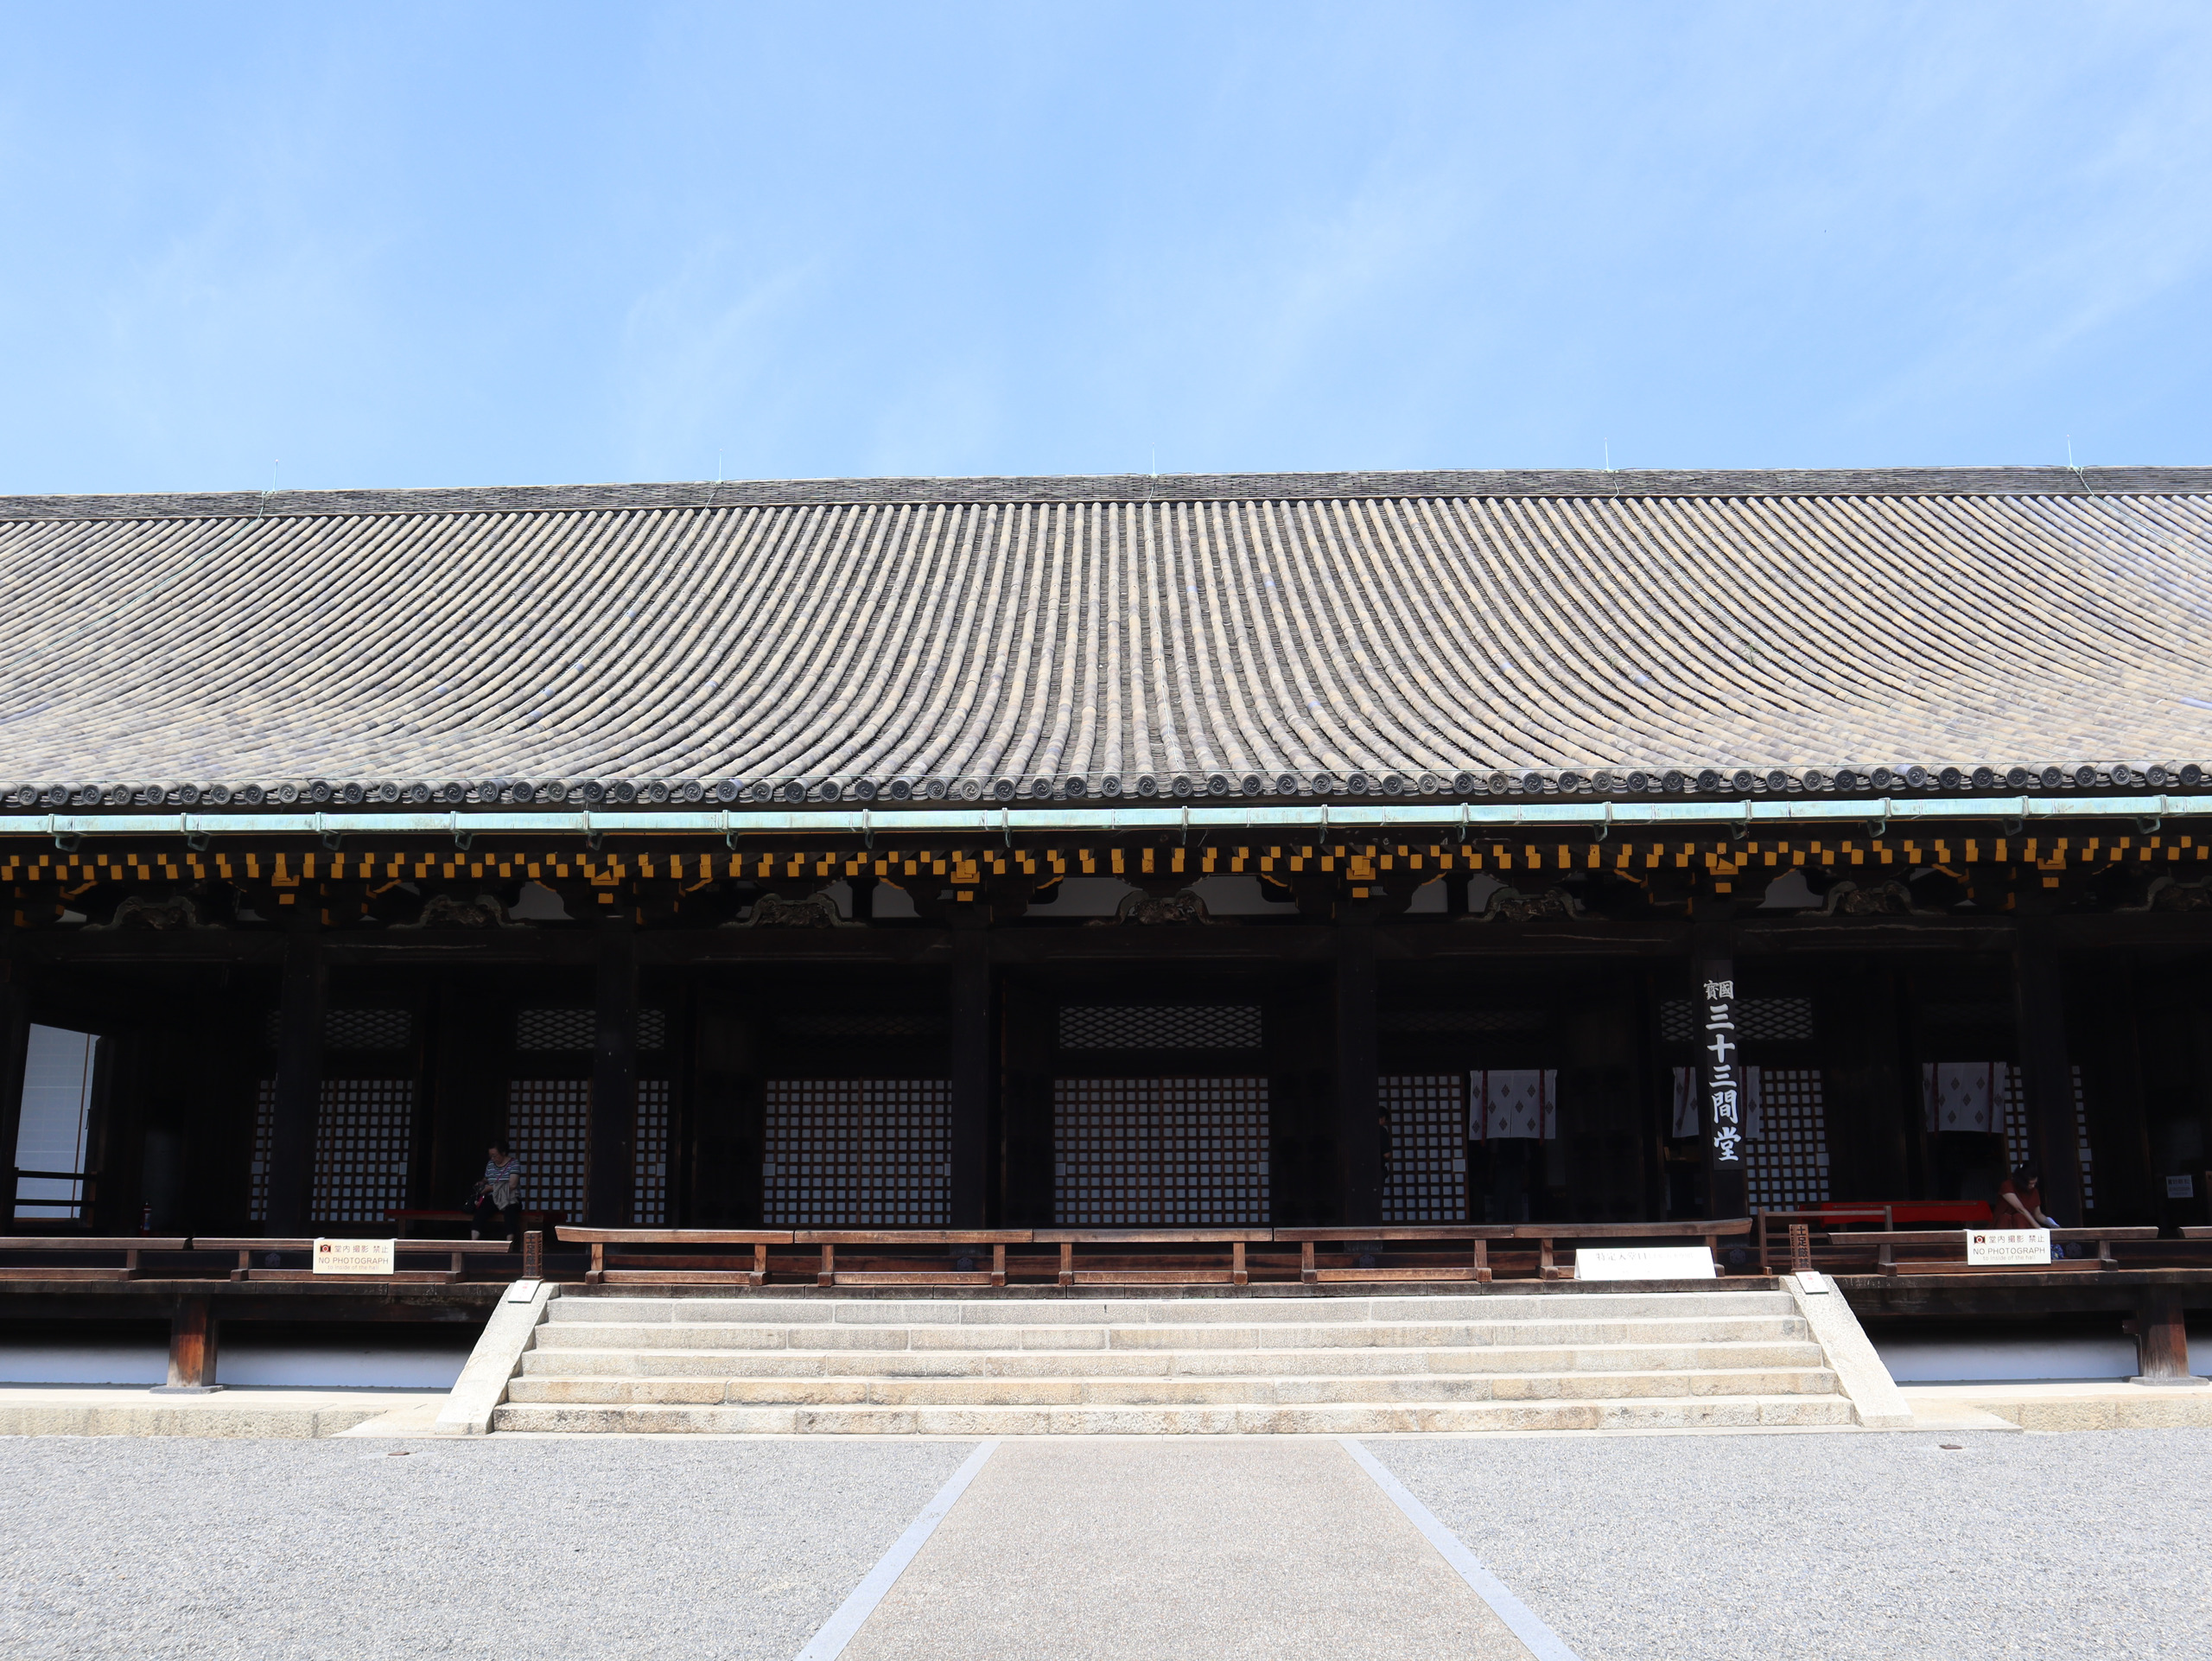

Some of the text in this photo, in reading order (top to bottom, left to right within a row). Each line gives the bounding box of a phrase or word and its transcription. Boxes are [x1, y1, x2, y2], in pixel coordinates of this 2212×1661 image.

[1706, 1003, 1742, 1161] 三十三間堂
